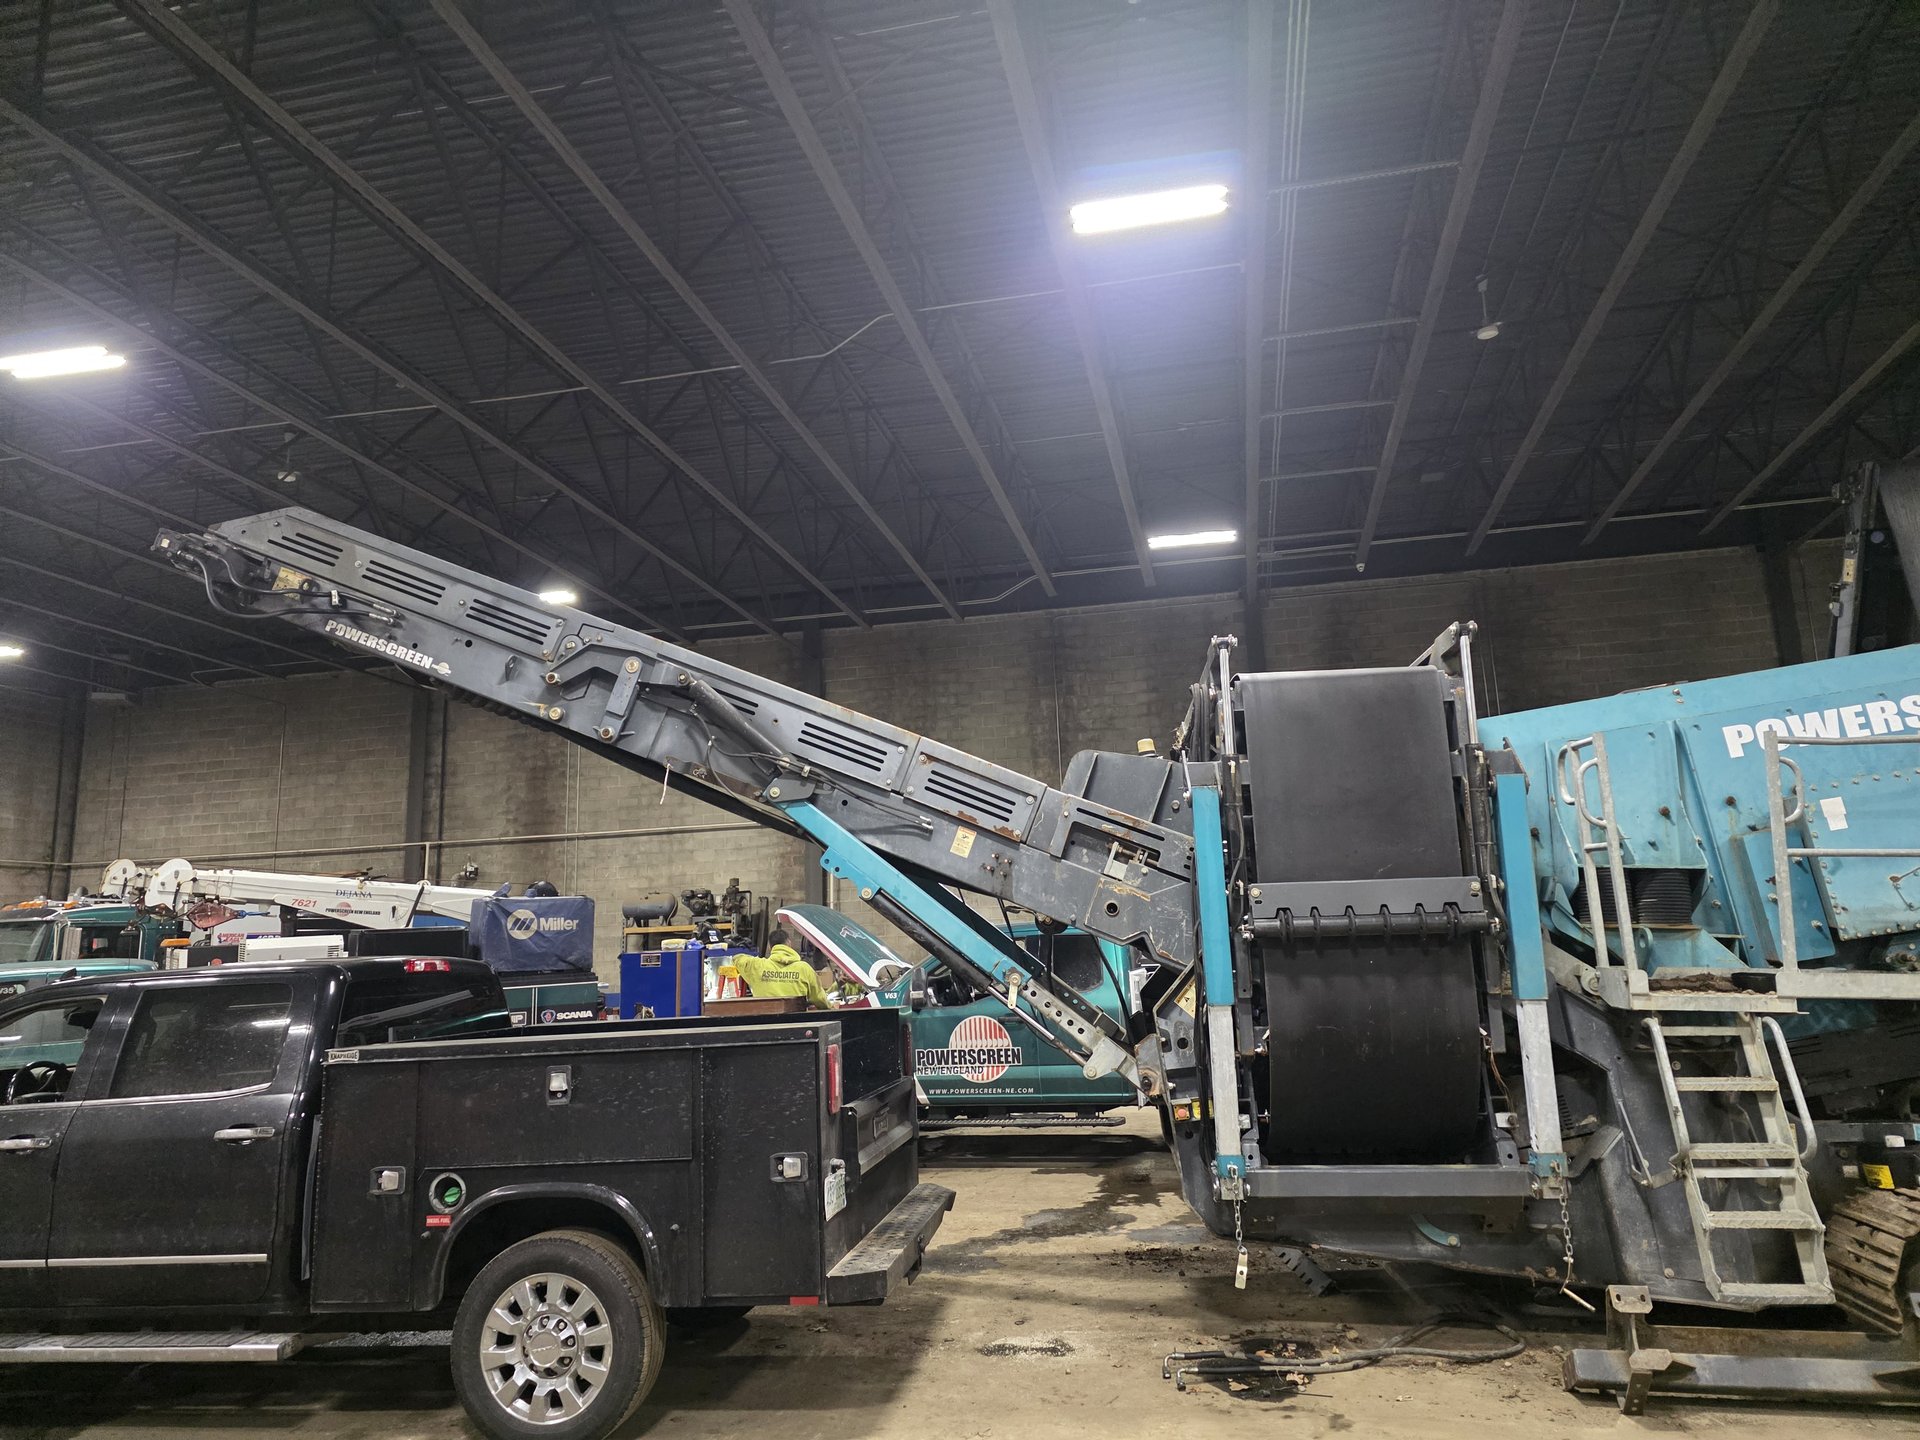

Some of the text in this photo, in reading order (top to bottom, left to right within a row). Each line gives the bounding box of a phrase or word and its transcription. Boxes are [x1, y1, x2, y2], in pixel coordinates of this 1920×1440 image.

[324, 619, 434, 669] POWERSCREEN
[335, 888, 372, 899] DEJANA
[291, 898, 318, 908] 7621
[540, 917, 579, 931] Miller
[762, 970, 799, 979] ASSOCIATED
[556, 1010, 593, 1020] SCANIA
[916, 1048, 1021, 1066] POWERSCREEN
[917, 1065, 984, 1076] NEW ENGLAND
[928, 1087, 1035, 1095] WWW.POWERSCREEN-NE.COM
